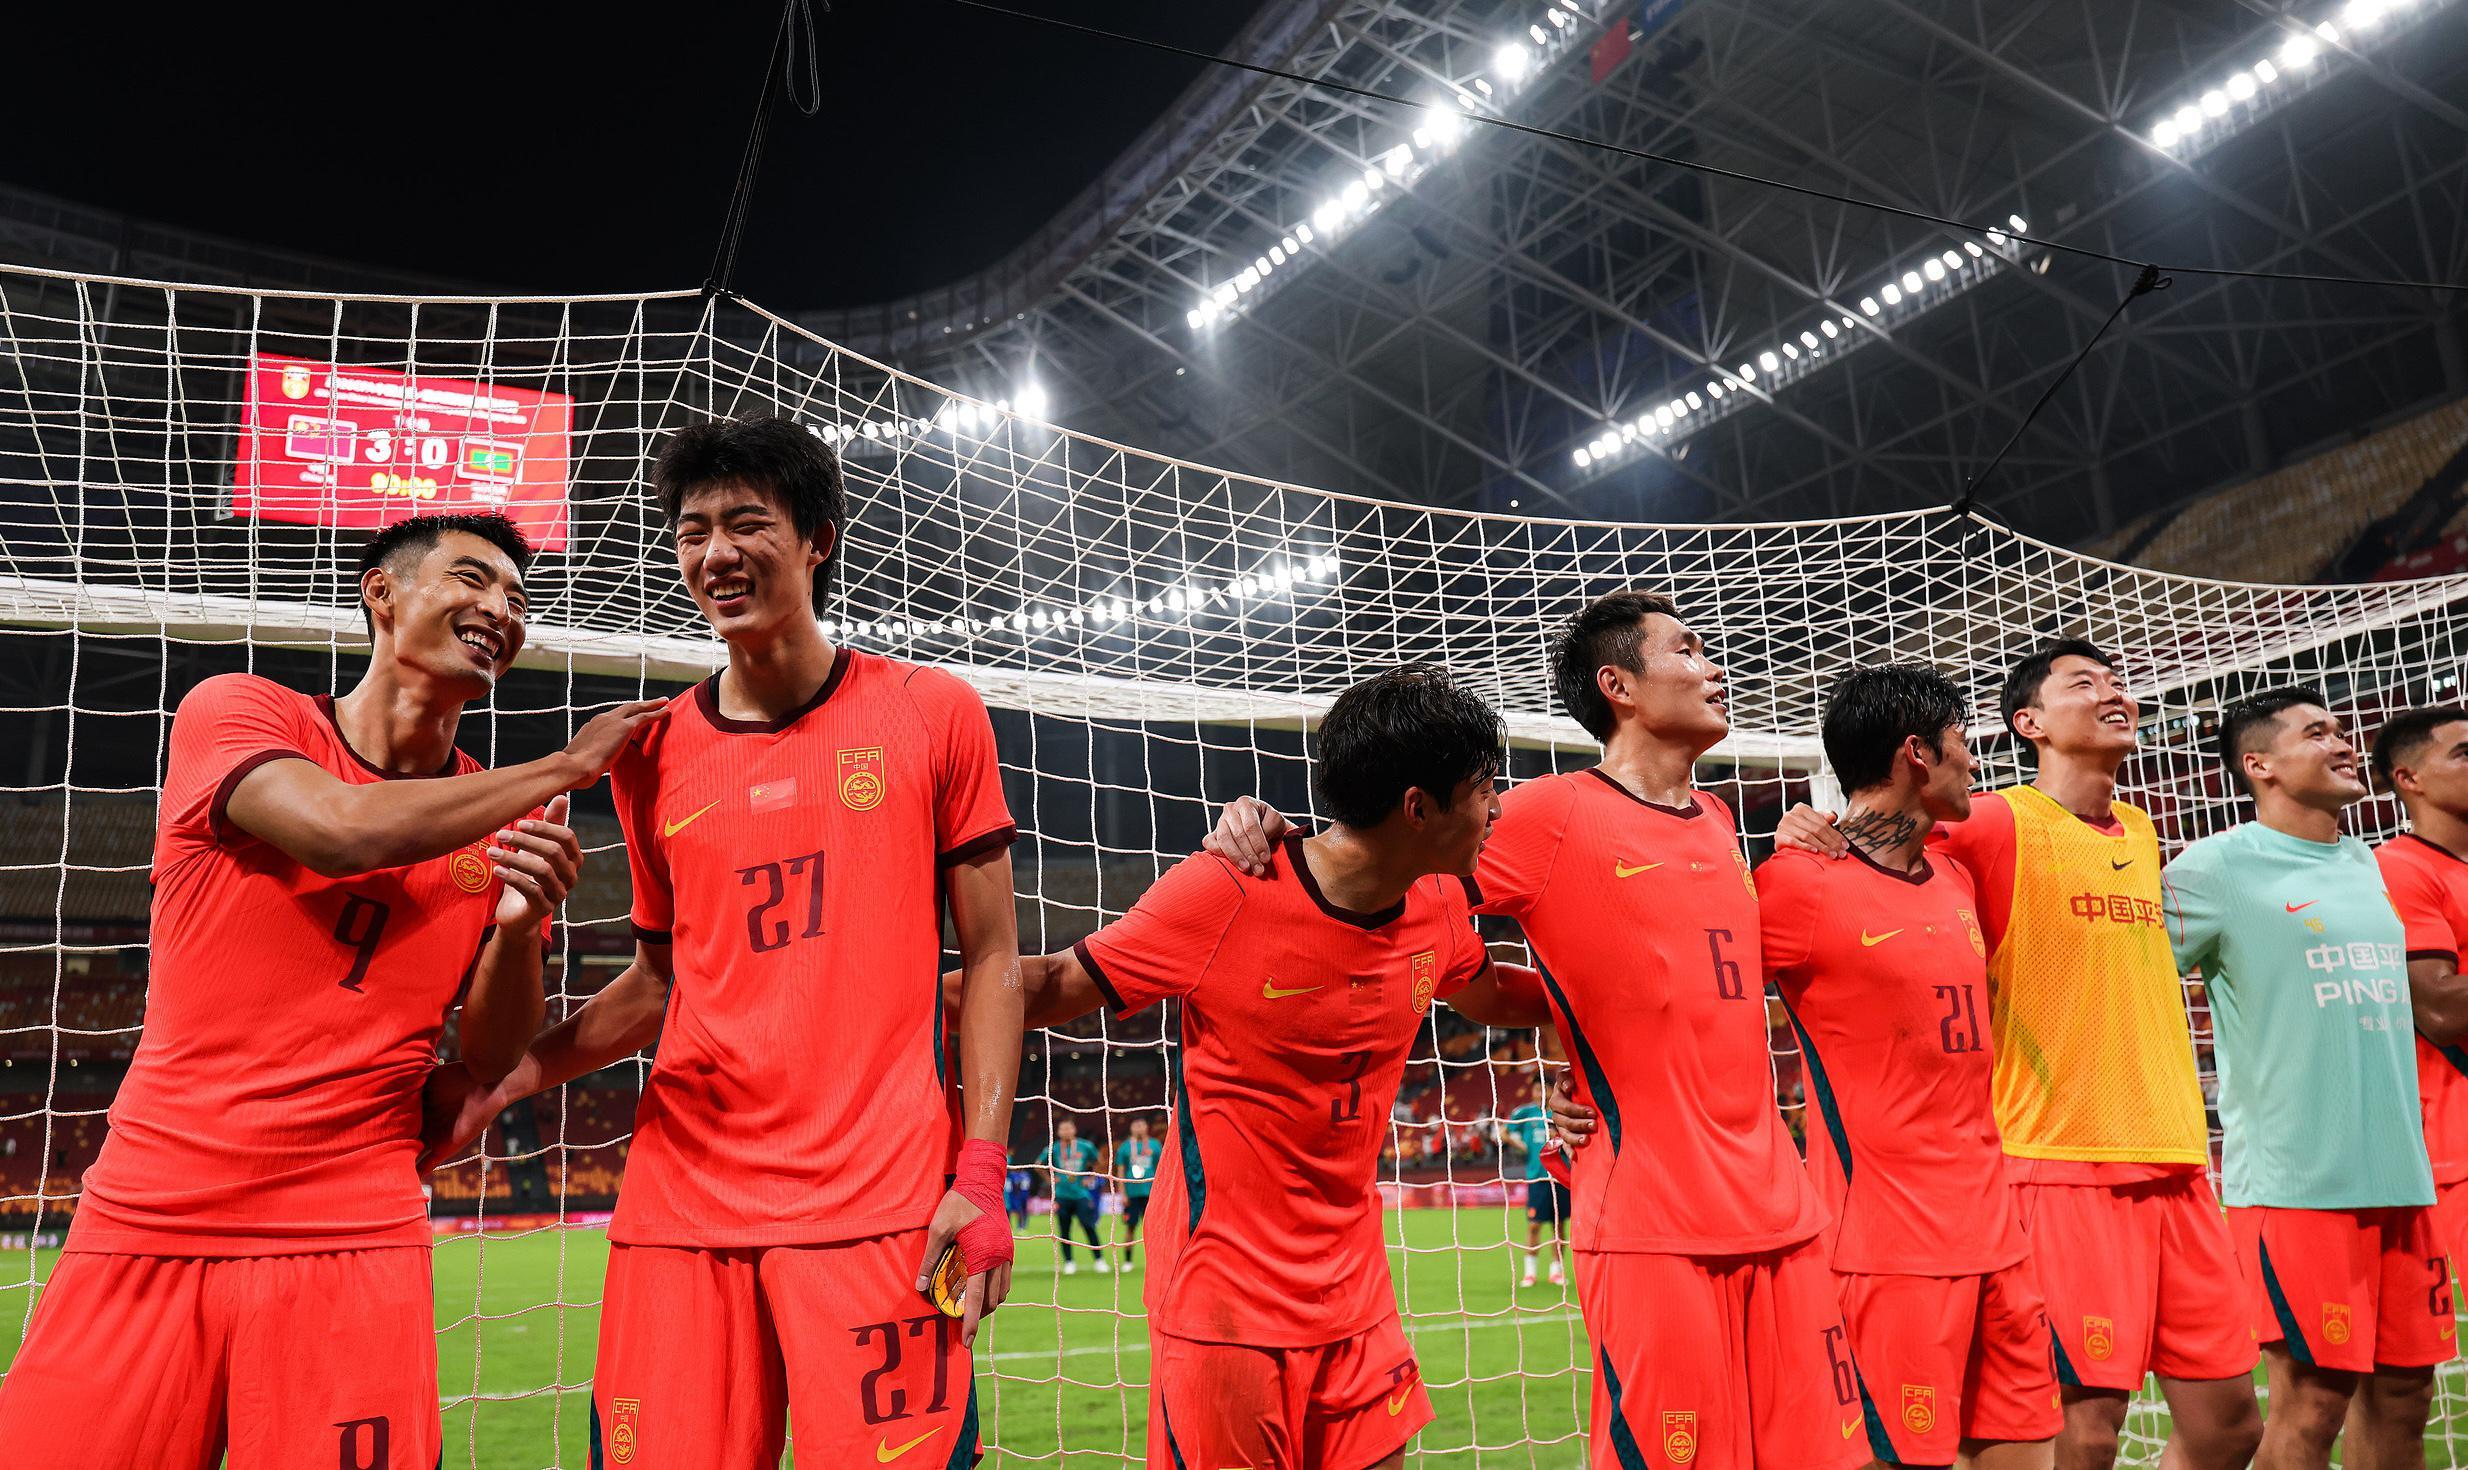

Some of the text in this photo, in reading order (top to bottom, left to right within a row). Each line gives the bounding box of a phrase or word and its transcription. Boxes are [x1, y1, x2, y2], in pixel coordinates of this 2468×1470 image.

[841, 751, 879, 764] CFA
[734, 850, 827, 953] 27
[334, 890, 391, 994] 9
[1415, 955, 1434, 970] CFA
[1704, 928, 1748, 1000] 6
[1931, 984, 1984, 1054] 21
[2313, 978, 2398, 1009] PING
[1331, 1050, 1373, 1123] 3
[848, 1313, 951, 1425] 27
[1820, 1325, 1858, 1406] 6
[1905, 1388, 1932, 1399] CFA
[615, 1402, 637, 1414] CFA
[1666, 1414, 1693, 1424] CFA
